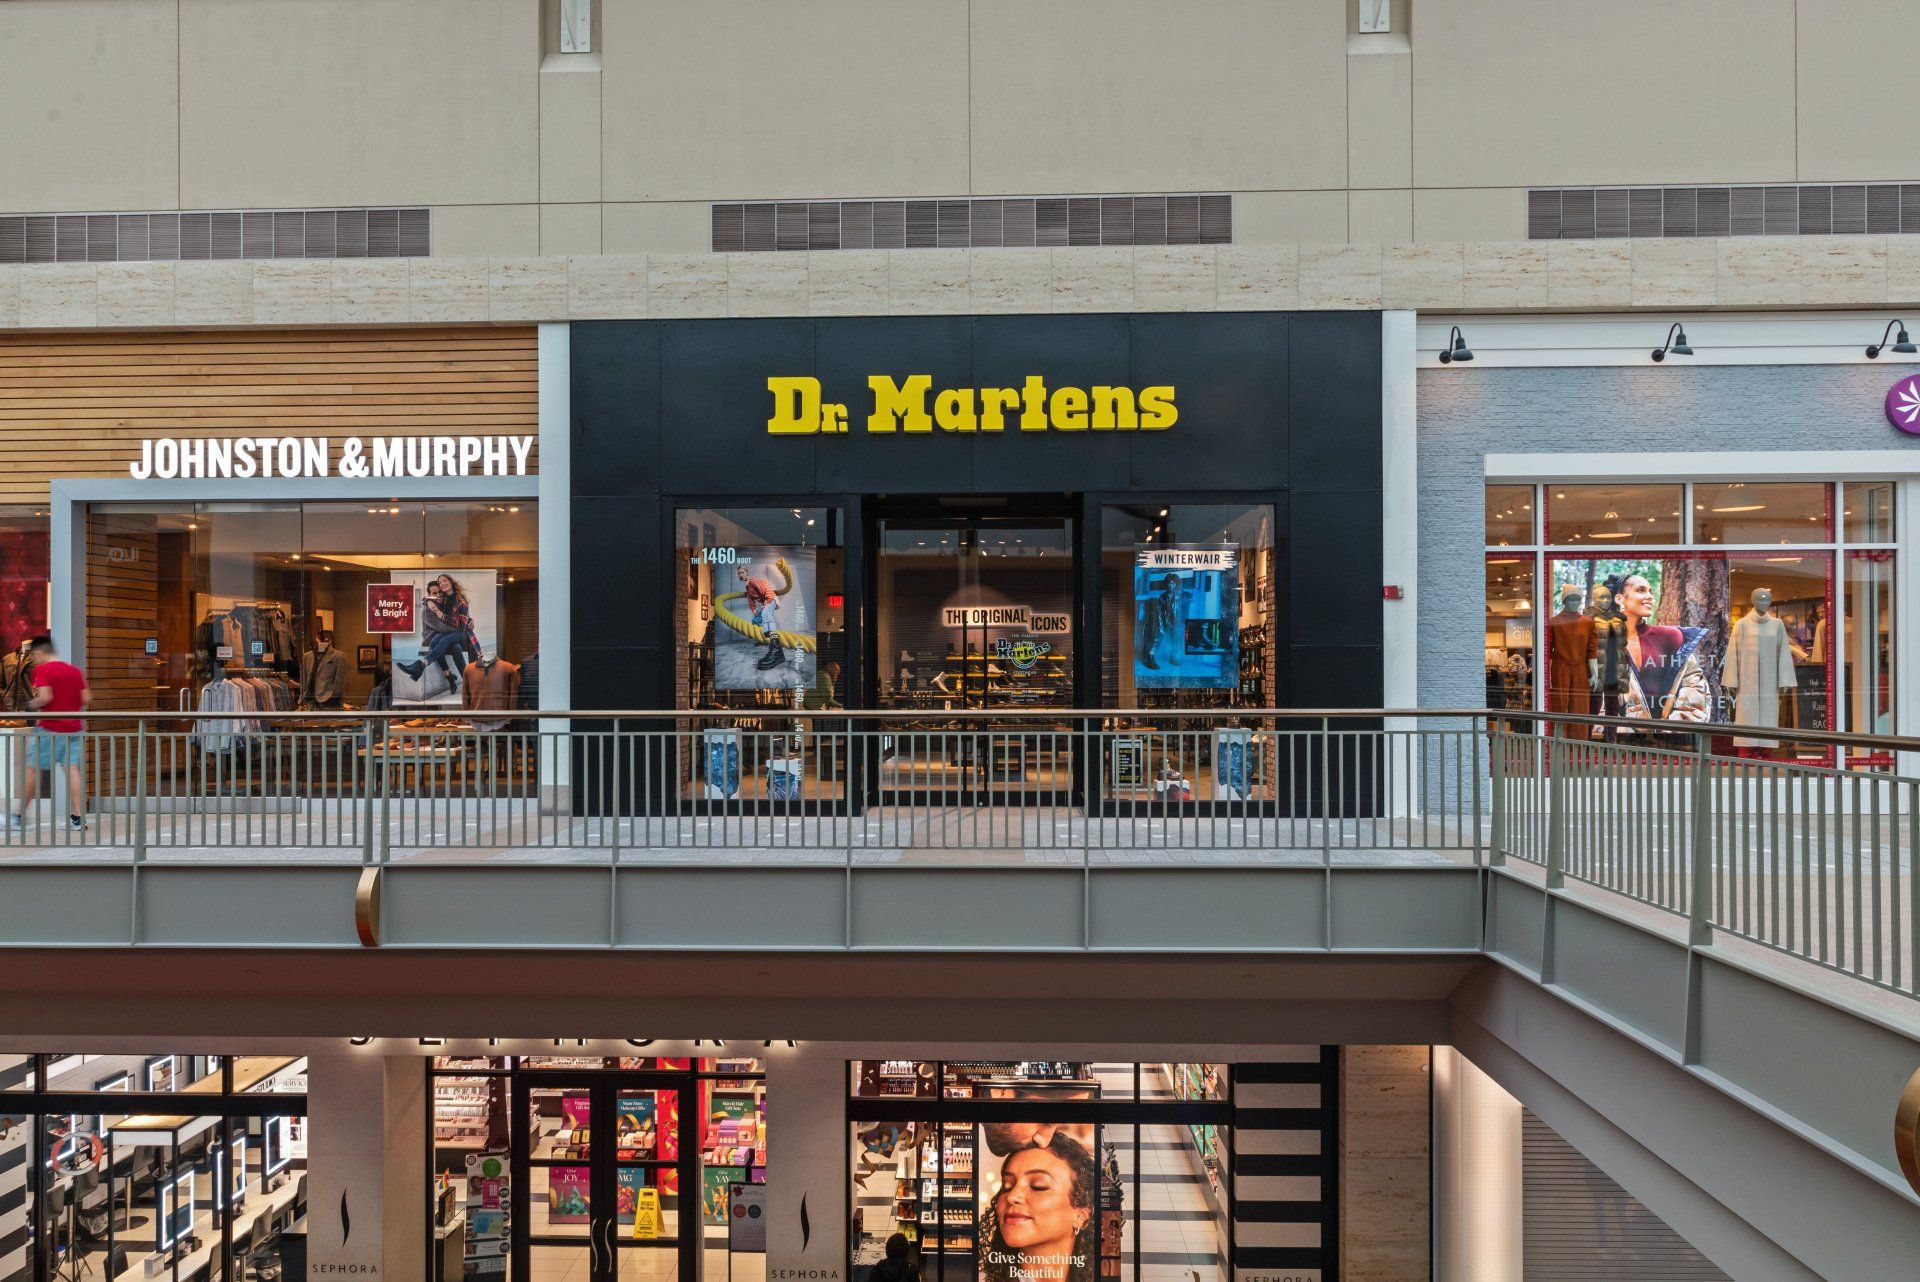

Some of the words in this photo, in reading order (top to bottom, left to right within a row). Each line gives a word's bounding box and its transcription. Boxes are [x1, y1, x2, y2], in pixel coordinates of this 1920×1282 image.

[768, 376, 849, 434] Dr.
[867, 374, 1179, 432] Martens
[130, 437, 328, 479] JOHNSTON
[702, 547, 736, 565] 1460
[1154, 553, 1221, 565] WINTERWAIR
[378, 600, 404, 609] Merry
[374, 609, 381, 617] &
[382, 609, 408, 618] Bright
[972, 607, 1028, 624] ORIGINAL
[1031, 616, 1067, 631] ICONS
[997, 642, 1050, 659] Martens
[795, 684, 804, 702] 1460
[563, 1174, 579, 1184] JOY
[988, 1252, 1016, 1264] Give
[1017, 1252, 1086, 1268] Something
[312, 1264, 378, 1274] SEPHORA
[771, 1269, 839, 1279] SEPHORA
[1009, 1266, 1064, 1279] Beautiful
